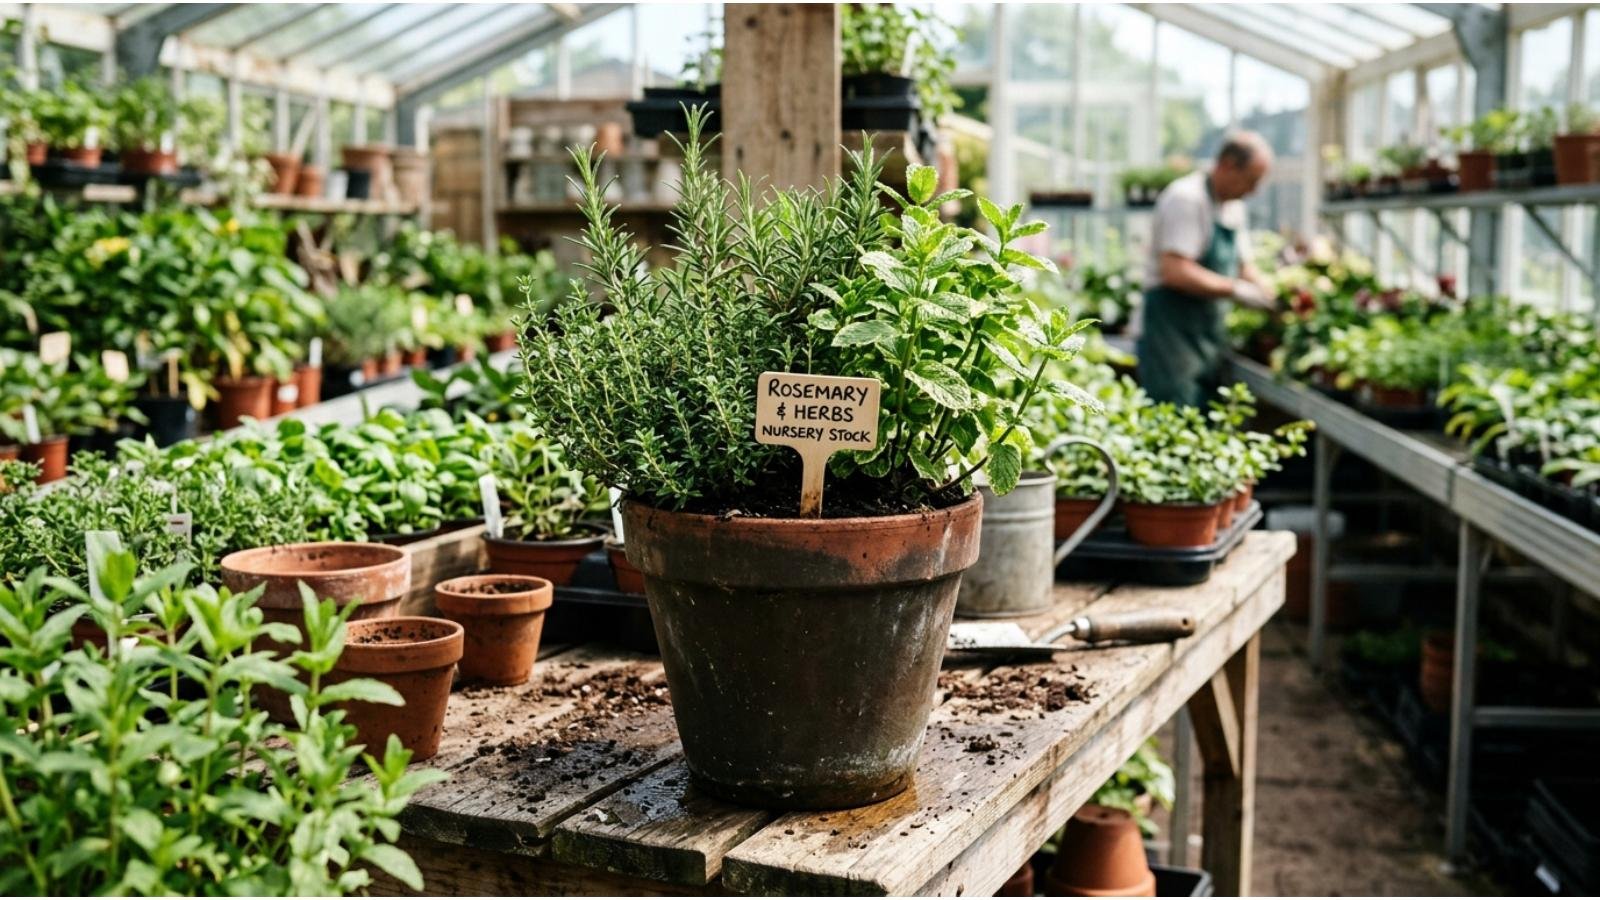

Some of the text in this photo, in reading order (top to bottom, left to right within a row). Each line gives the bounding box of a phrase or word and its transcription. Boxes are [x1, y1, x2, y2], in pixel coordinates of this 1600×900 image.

[768, 378, 868, 406] ROSEMARY
[776, 402, 854, 422] & HERBS
[762, 425, 871, 443] NURSERY STOCK
